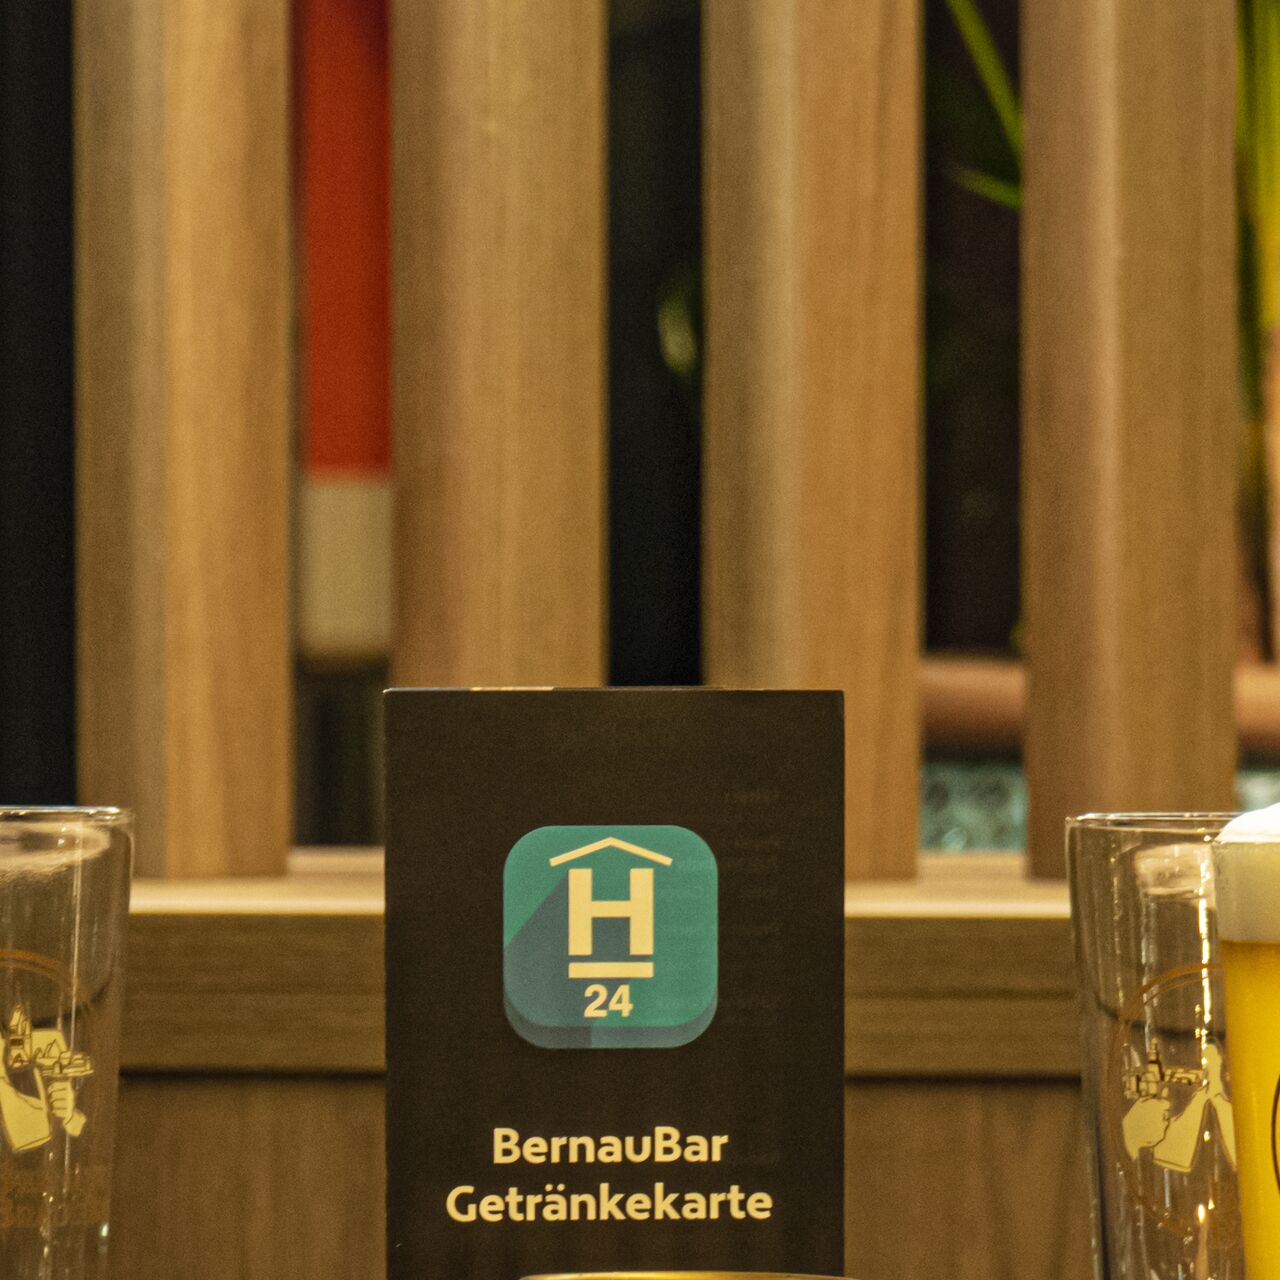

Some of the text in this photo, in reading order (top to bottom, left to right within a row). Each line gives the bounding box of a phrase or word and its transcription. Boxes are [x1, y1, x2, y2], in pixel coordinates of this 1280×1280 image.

[568, 867, 655, 956] H
[583, 983, 634, 1018] 24
[492, 1125, 729, 1165] BernauBar
[445, 1181, 773, 1223] Getränkekarte
